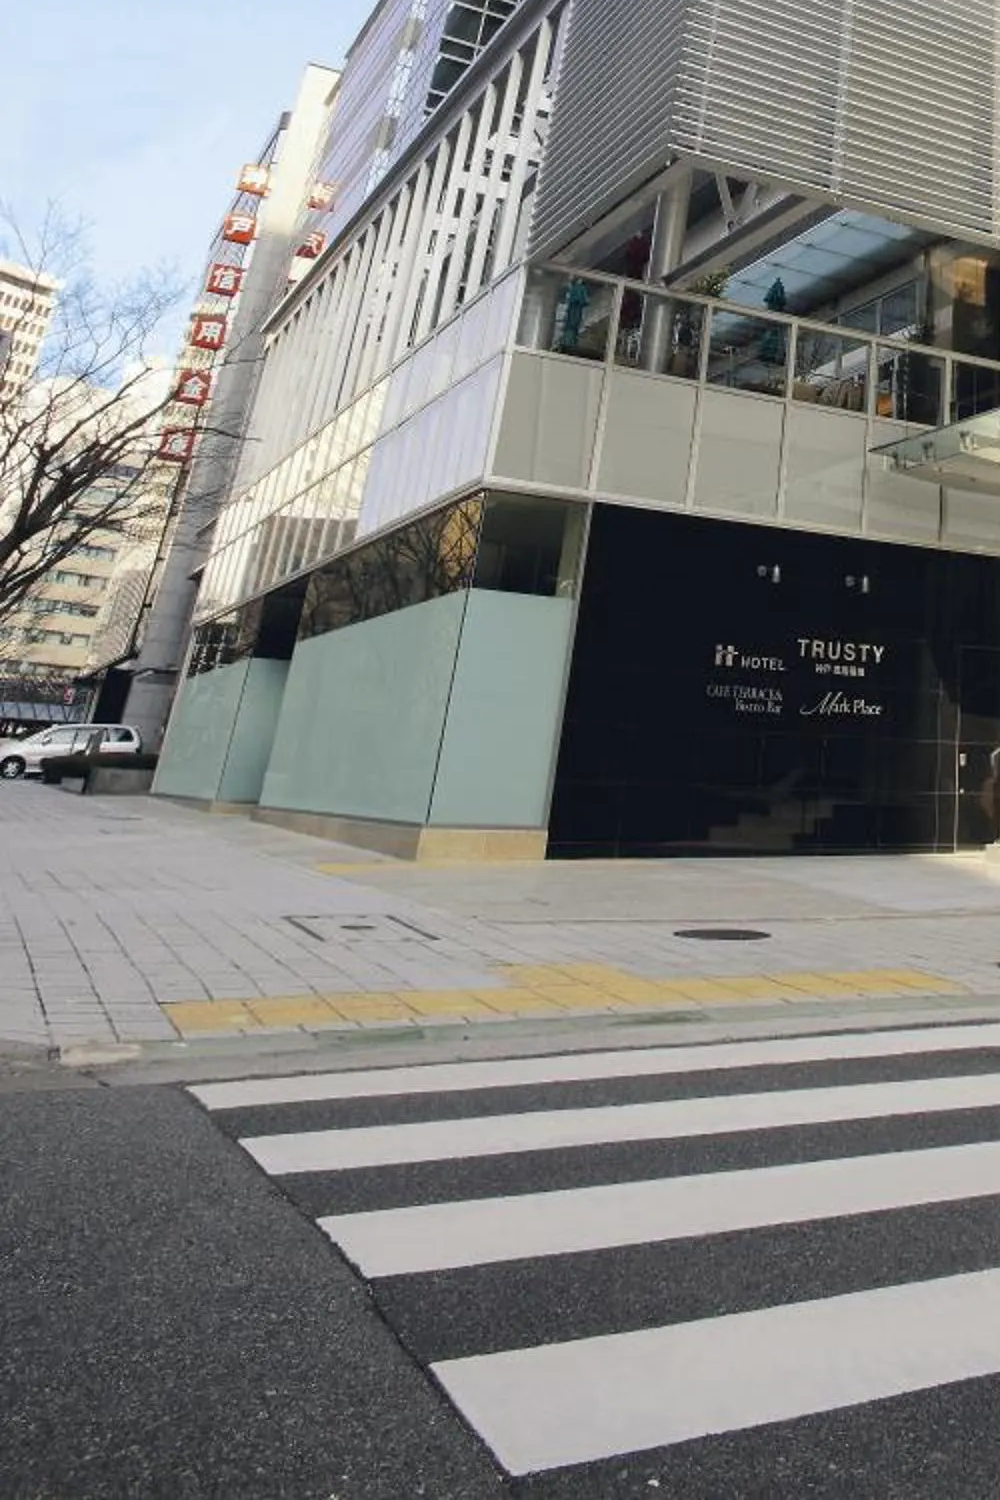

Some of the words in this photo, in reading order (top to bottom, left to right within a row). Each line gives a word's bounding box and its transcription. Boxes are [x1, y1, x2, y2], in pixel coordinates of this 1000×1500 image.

[797, 639, 884, 663] TRUSTY
[740, 656, 785, 671] HOTEL
[799, 691, 850, 716] Mark
[853, 699, 882, 714] Place
